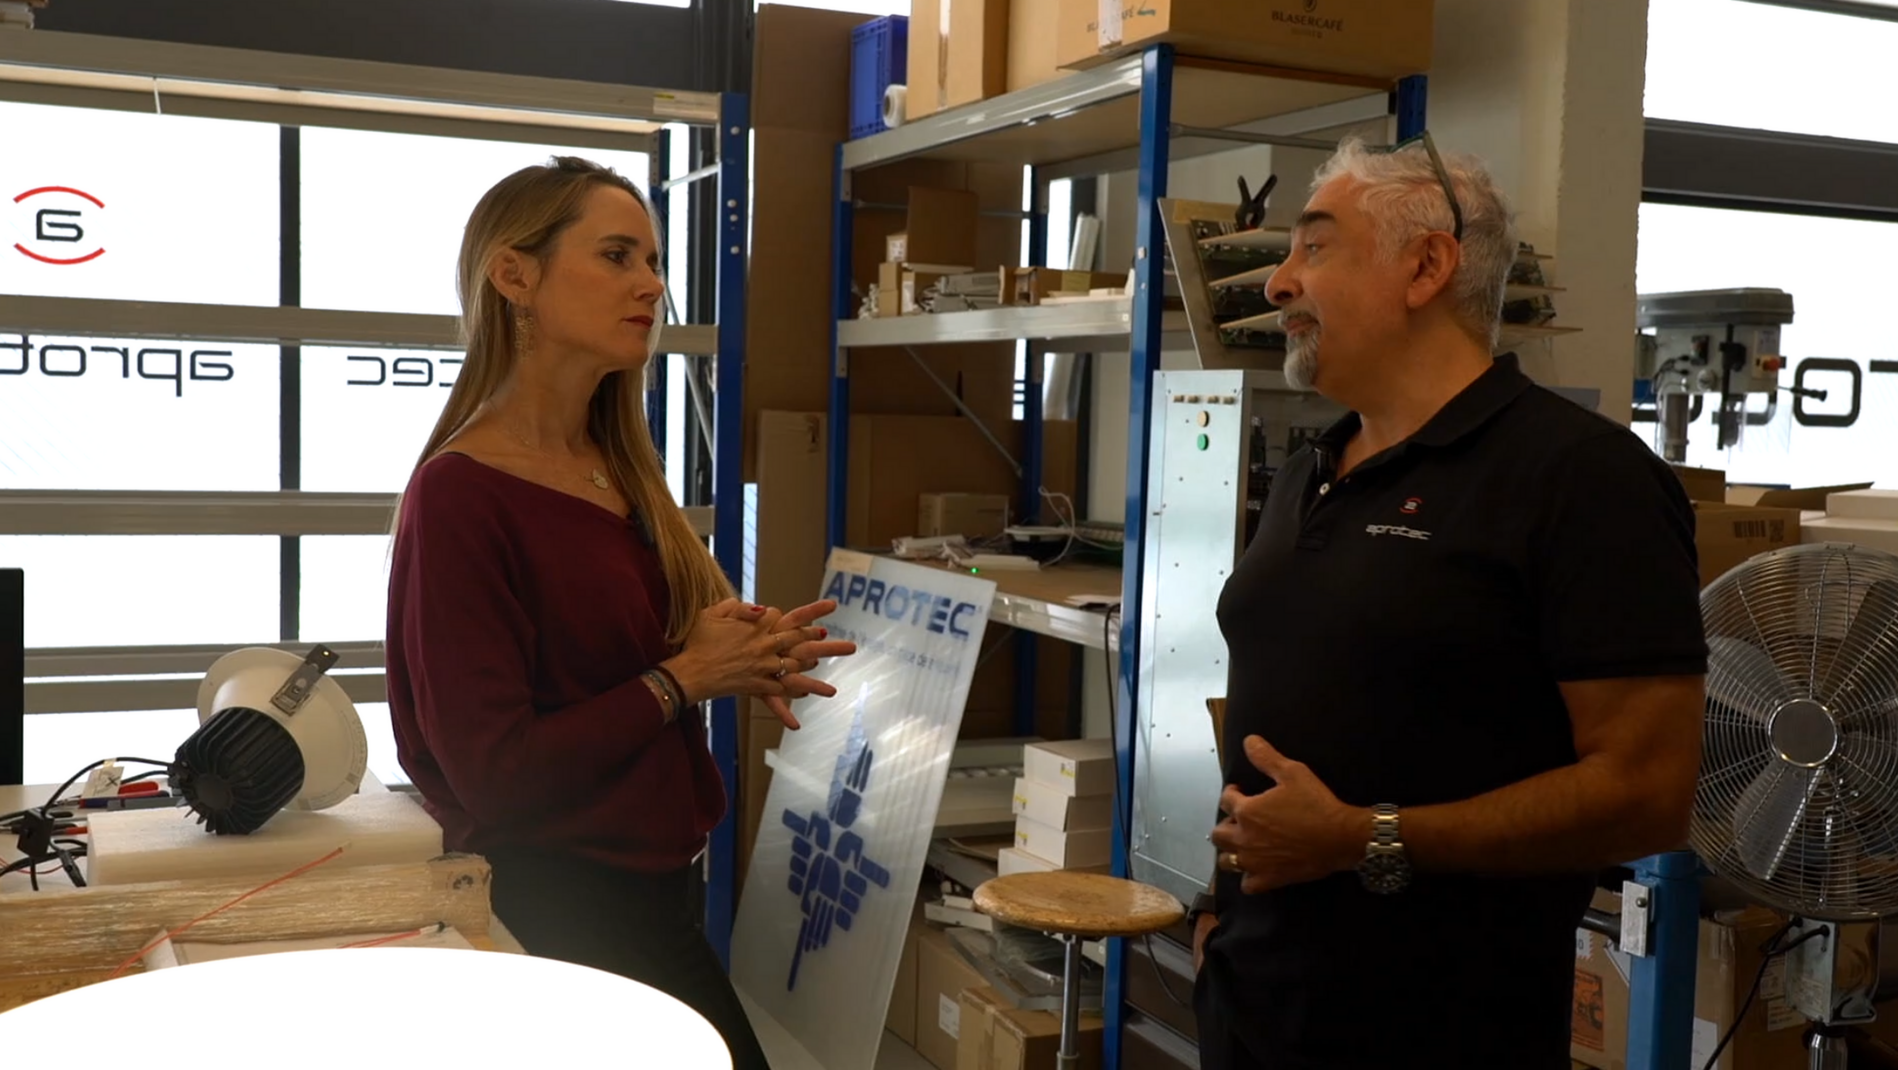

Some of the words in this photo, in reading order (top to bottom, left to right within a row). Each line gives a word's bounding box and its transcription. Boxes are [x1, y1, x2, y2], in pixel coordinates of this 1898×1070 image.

[1271, 9, 1343, 32] BLASERCAFÉ
[1365, 523, 1432, 541] aprotec
[823, 571, 976, 638] APROTEC
